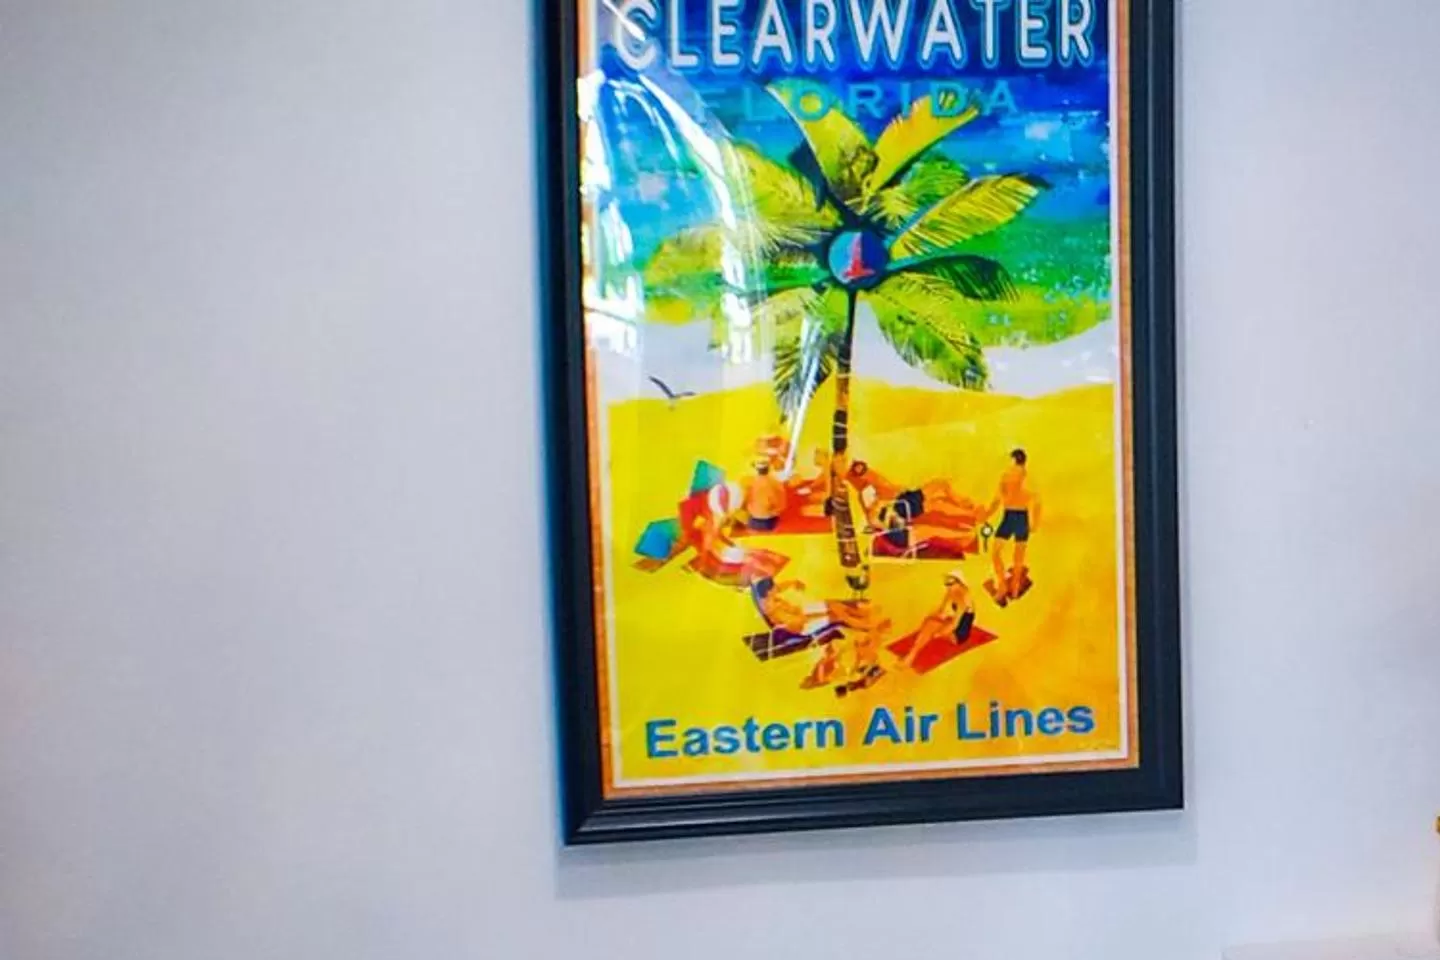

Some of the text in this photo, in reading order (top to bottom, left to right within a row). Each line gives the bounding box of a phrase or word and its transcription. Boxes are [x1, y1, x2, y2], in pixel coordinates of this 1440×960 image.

[615, 0, 1095, 71] CLEARWATER
[645, 701, 1096, 759] Eastern Air Lines
